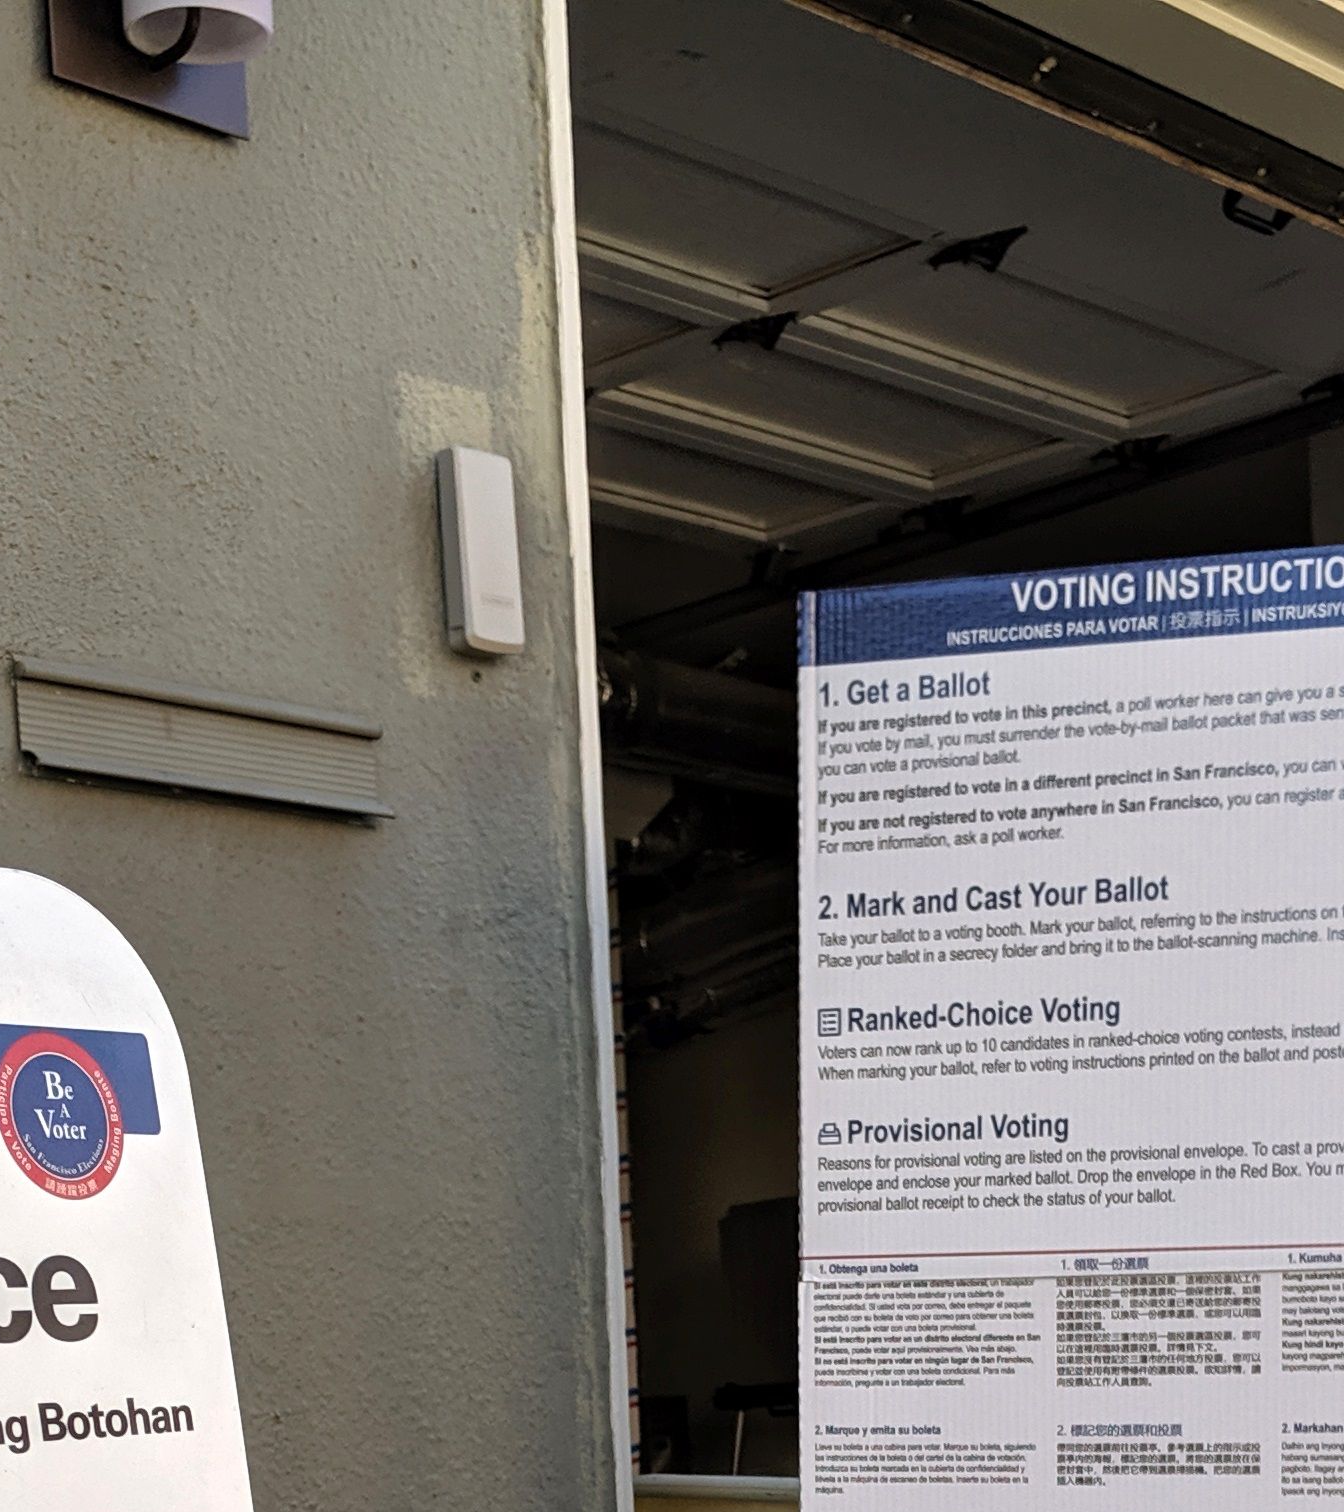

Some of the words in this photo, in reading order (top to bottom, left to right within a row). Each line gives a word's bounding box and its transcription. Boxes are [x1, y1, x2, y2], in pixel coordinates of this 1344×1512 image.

[1013, 573, 1135, 612] VOTING
[947, 622, 1063, 647] INSTRUCCIONES
[1066, 619, 1106, 636] PARA
[1109, 615, 1158, 633] VOTAR
[816, 682, 837, 707] 1.
[847, 679, 889, 706] Get
[897, 682, 910, 702] a
[919, 671, 989, 700] Ballot
[819, 894, 837, 920] 2.
[847, 890, 904, 919] Mark
[913, 886, 958, 914] and
[966, 884, 1021, 912] Cast
[1030, 881, 1086, 908] Your
[1095, 876, 1168, 904] Ballot
[848, 1001, 1032, 1033] Ranked-Choice
[1041, 996, 1120, 1027] Voting
[42, 1070, 75, 1100] Be
[33, 1108, 87, 1140] Voter
[59, 1103, 72, 1119] A
[848, 1115, 982, 1145] Provisional
[991, 1112, 1069, 1144] Voting
[818, 1197, 882, 1216] provisional
[886, 1196, 919, 1211] ballot
[922, 1195, 964, 1212] receipt
[967, 1195, 979, 1209] to
[983, 1192, 1020, 1208] check
[1024, 1193, 1043, 1207] the
[1047, 1191, 1085, 1206] status
[1089, 1189, 1102, 1205] of
[1105, 1192, 1133, 1209] your
[1137, 1188, 1175, 1204] ballot.
[819, 1264, 827, 1274] 1.
[829, 1263, 868, 1276] Obtenga
[870, 1264, 888, 1274] una
[890, 1262, 919, 1273] boleta
[1288, 1253, 1296, 1264] 1.
[1299, 1252, 1342, 1264] Kumuha
[39, 1397, 193, 1442] Botohan
[815, 1425, 823, 1436] 2.
[825, 1425, 860, 1437] Marque
[862, 1426, 868, 1437] y
[870, 1425, 896, 1435] emita
[898, 1426, 910, 1435] su
[912, 1424, 941, 1435] boleta
[1282, 1423, 1290, 1434] 2.
[1293, 1422, 1344, 1433] Markahan
